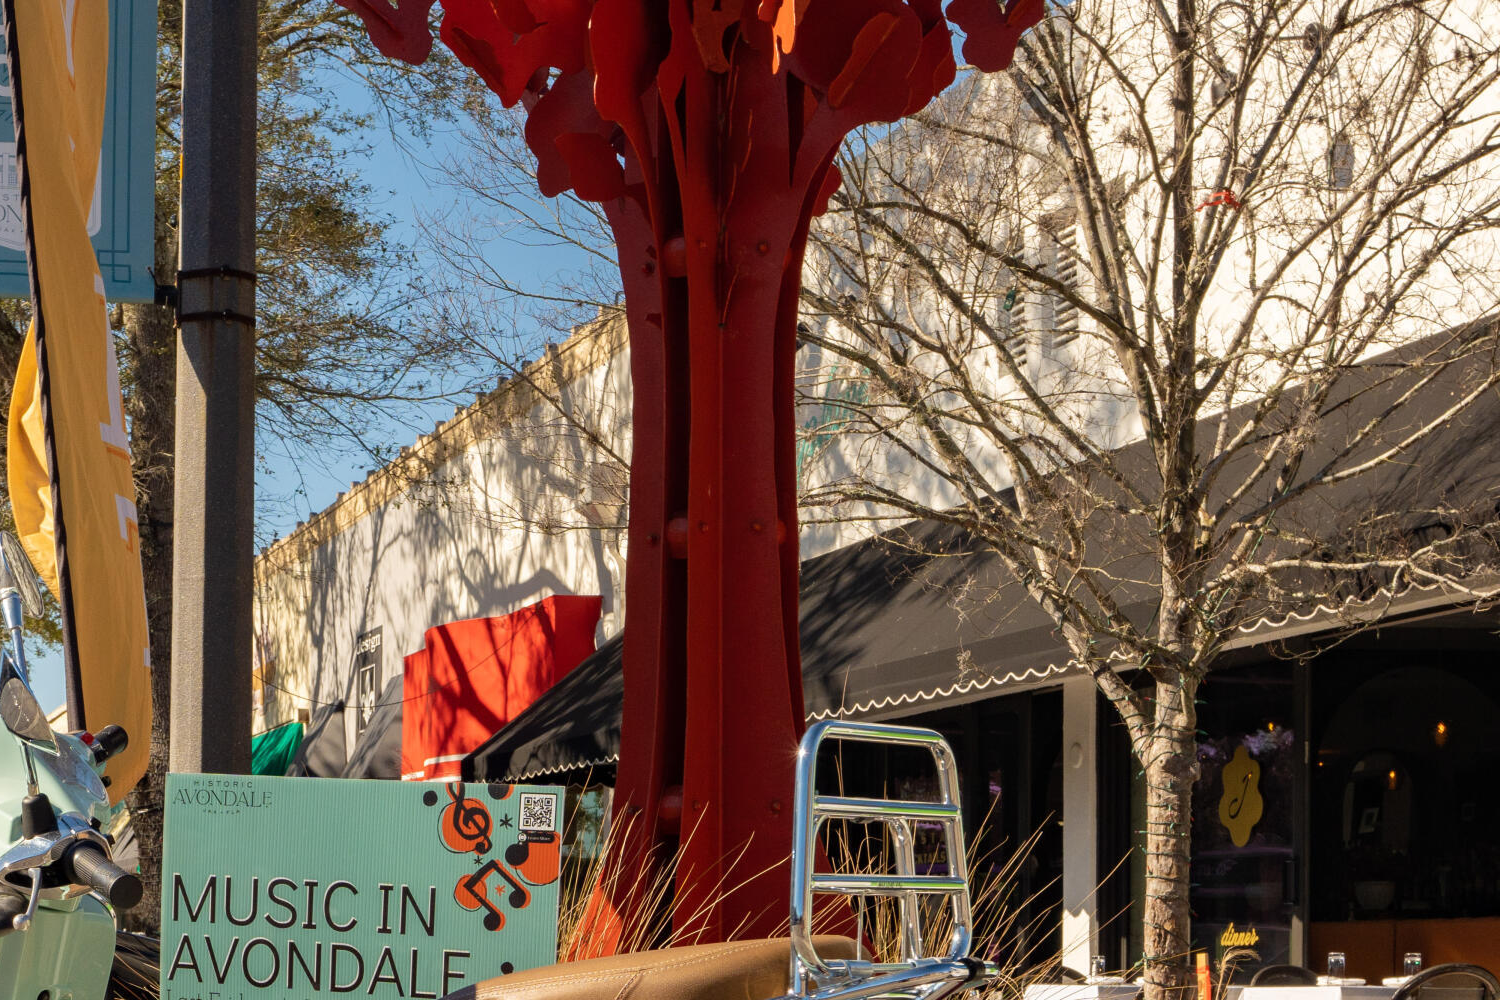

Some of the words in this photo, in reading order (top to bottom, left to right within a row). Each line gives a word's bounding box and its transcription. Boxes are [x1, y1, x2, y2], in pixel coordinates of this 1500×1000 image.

[356, 633, 380, 655] design
[193, 780, 253, 788] HISTORIC
[173, 788, 273, 808] AVONDALE
[172, 872, 358, 932] MUSIC
[376, 883, 437, 937] IN
[1221, 922, 1259, 946] dinner
[167, 933, 471, 999] AVONDALE
